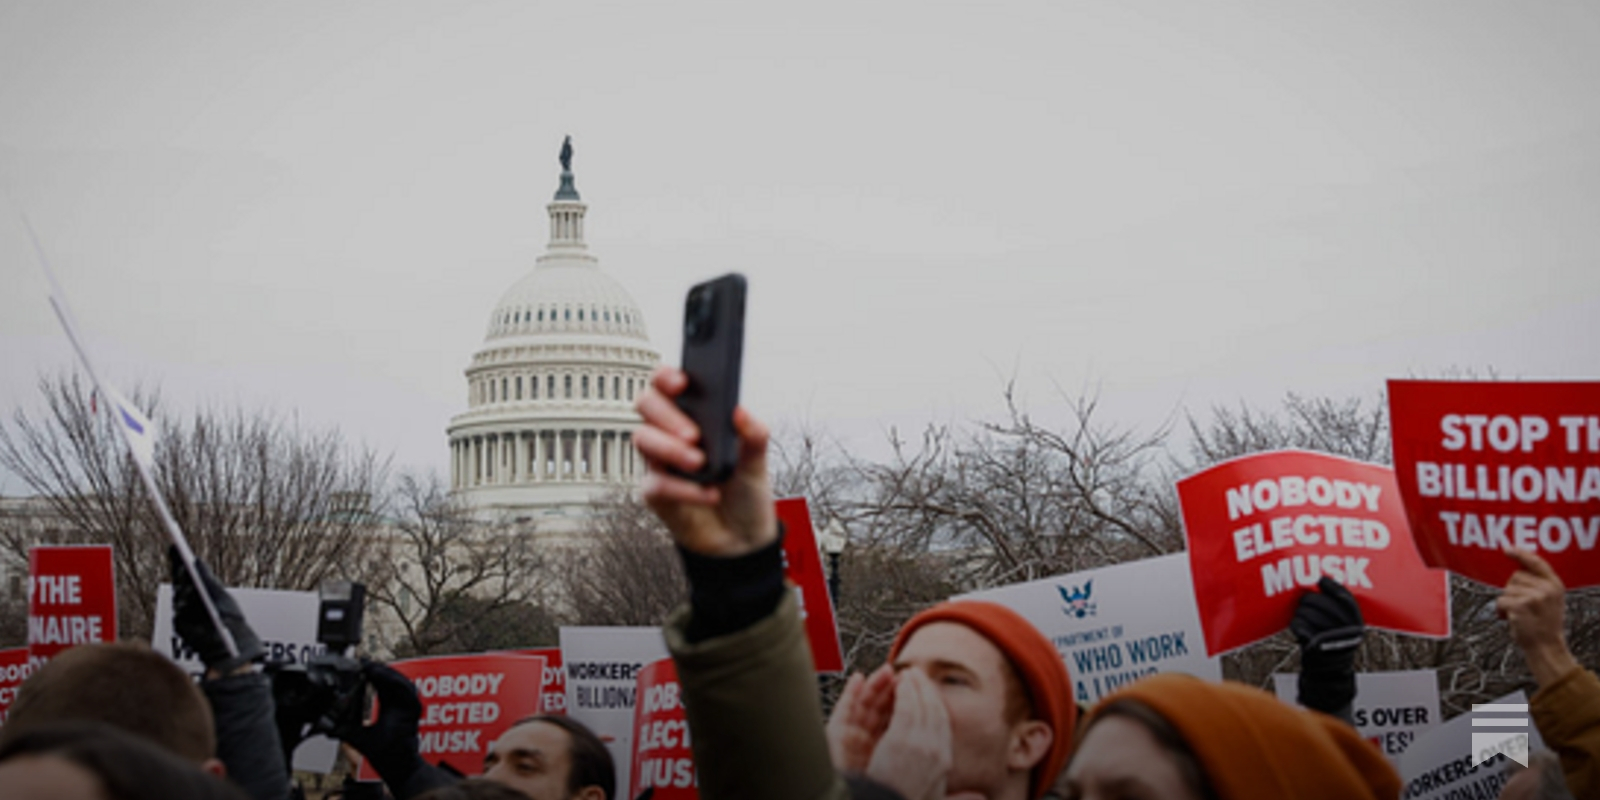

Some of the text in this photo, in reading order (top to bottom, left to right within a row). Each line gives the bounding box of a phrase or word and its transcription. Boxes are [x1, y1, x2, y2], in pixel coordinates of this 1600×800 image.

[1440, 413, 1549, 452] STOP
[1225, 475, 1382, 521] NOBODY
[1416, 461, 1600, 503] BILLIONA
[1232, 514, 1391, 562] ELECTED
[1438, 511, 1600, 553] TAKEOV
[38, 575, 82, 604] THE
[1261, 553, 1374, 598] MUSK
[1072, 630, 1189, 675] WHO WORK
[1077, 680, 1089, 701] A
[418, 701, 500, 727] ECTED
[1371, 706, 1429, 727] OVER
[639, 758, 698, 788] MUS
